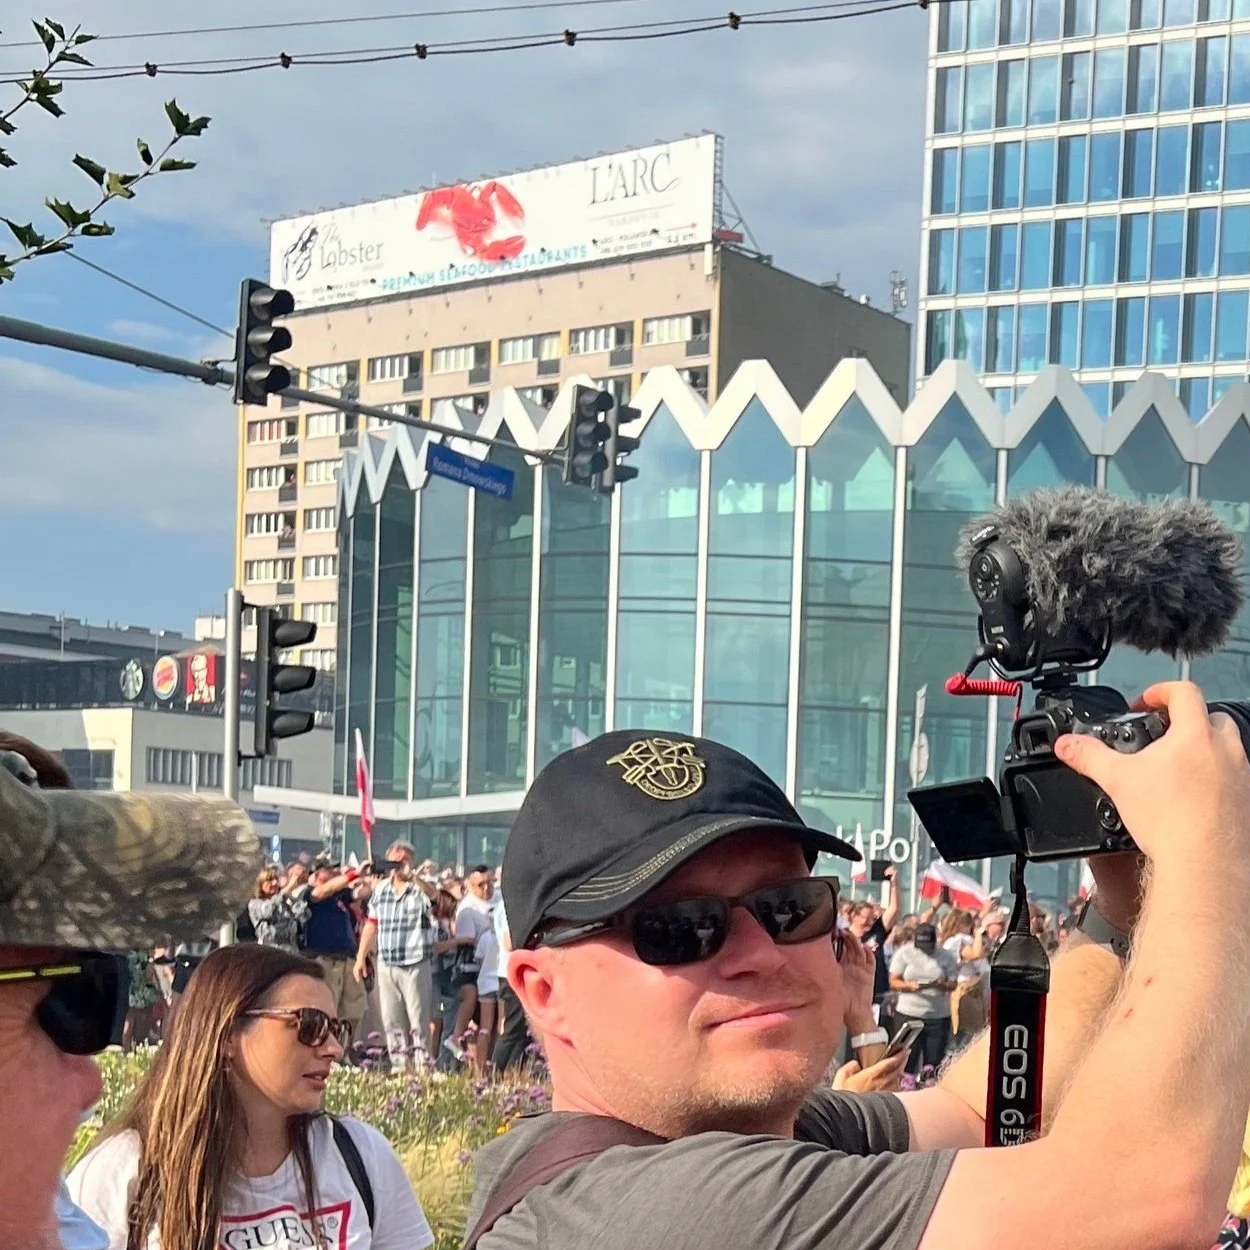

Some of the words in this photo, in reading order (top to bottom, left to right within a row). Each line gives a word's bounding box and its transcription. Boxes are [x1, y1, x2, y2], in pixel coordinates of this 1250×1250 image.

[589, 152, 680, 205] L'ARC
[320, 240, 385, 270] Lobster
[382, 271, 435, 291] PREMIUM
[438, 262, 495, 282] SEAFOOD
[1002, 1024, 1029, 1099] EOS
